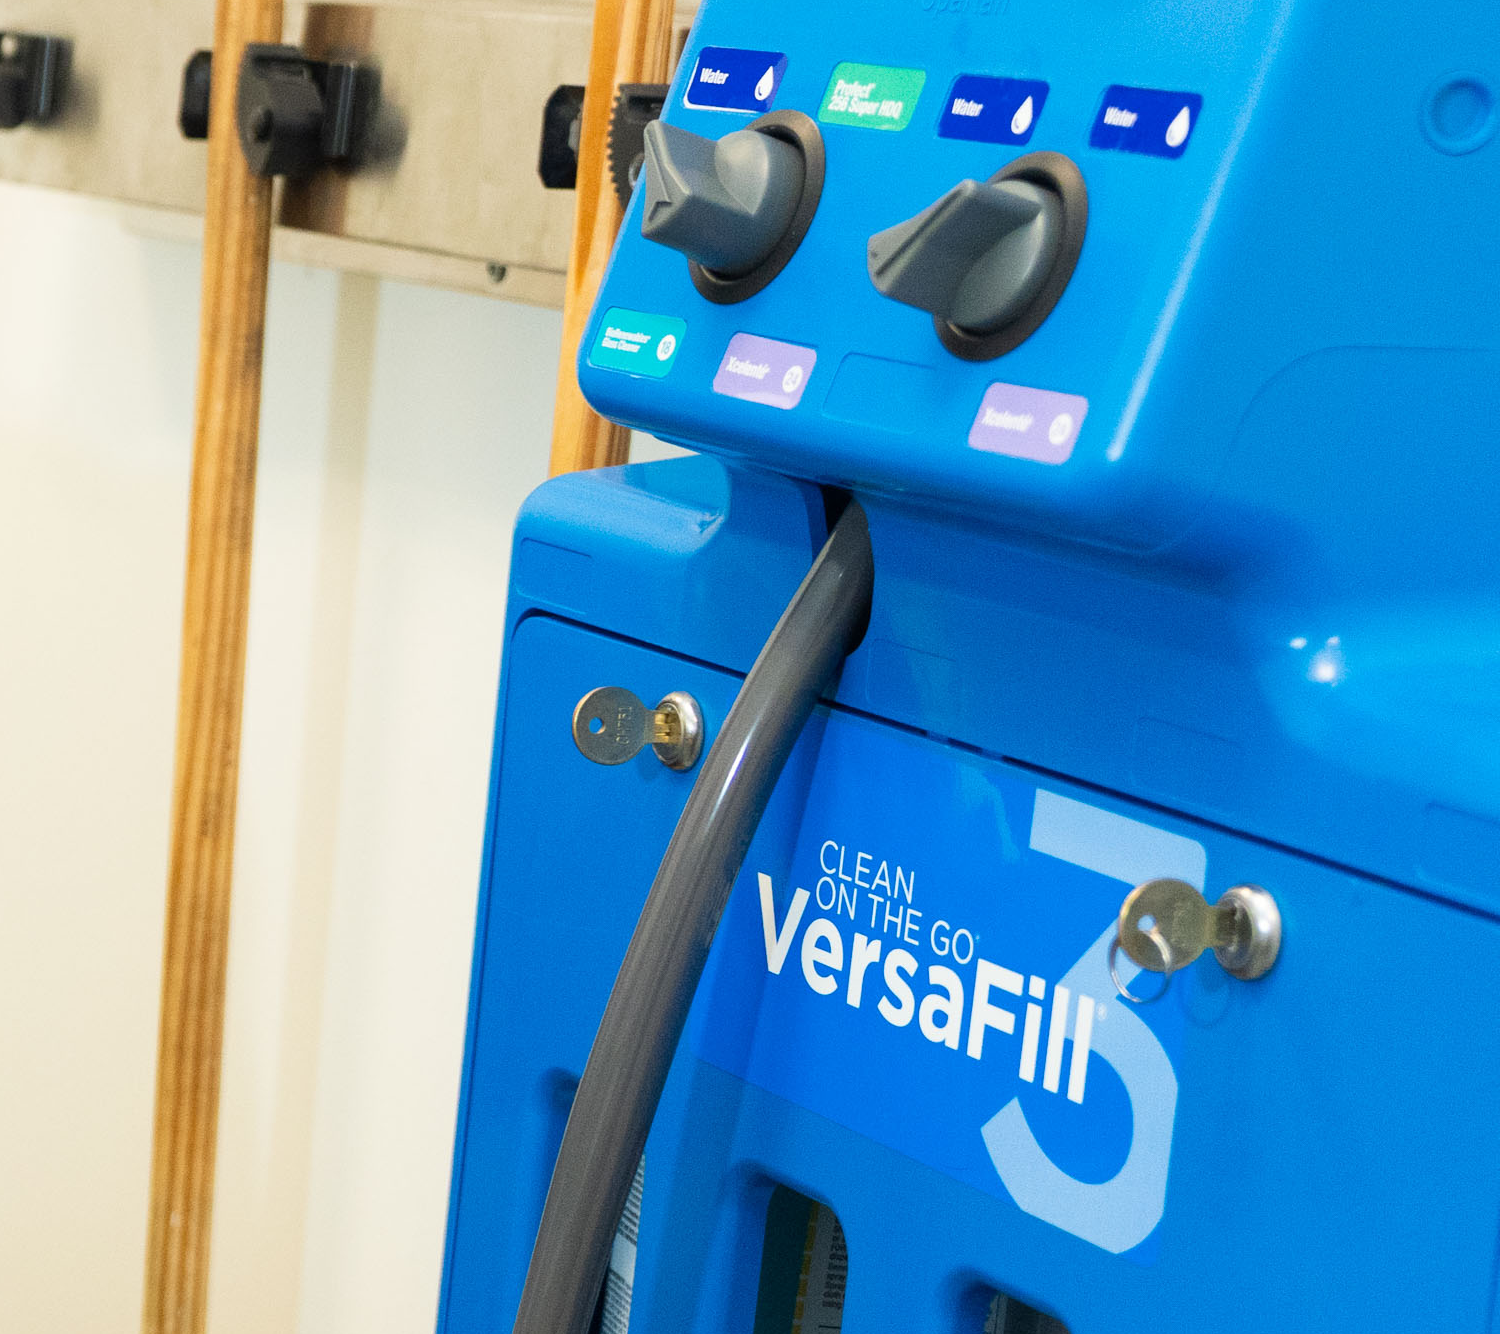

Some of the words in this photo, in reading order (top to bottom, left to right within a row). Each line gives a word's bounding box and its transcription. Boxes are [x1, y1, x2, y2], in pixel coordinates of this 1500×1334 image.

[700, 67, 729, 85] Water
[848, 99, 878, 117] Super
[878, 100, 904, 118] HDQ
[951, 98, 984, 117] Water
[1103, 106, 1138, 128] Water
[820, 840, 914, 903] CLEAN
[816, 876, 858, 917] ON
[867, 889, 922, 946] THE
[931, 920, 974, 965] GO
[758, 872, 1096, 1105] VersaFill
